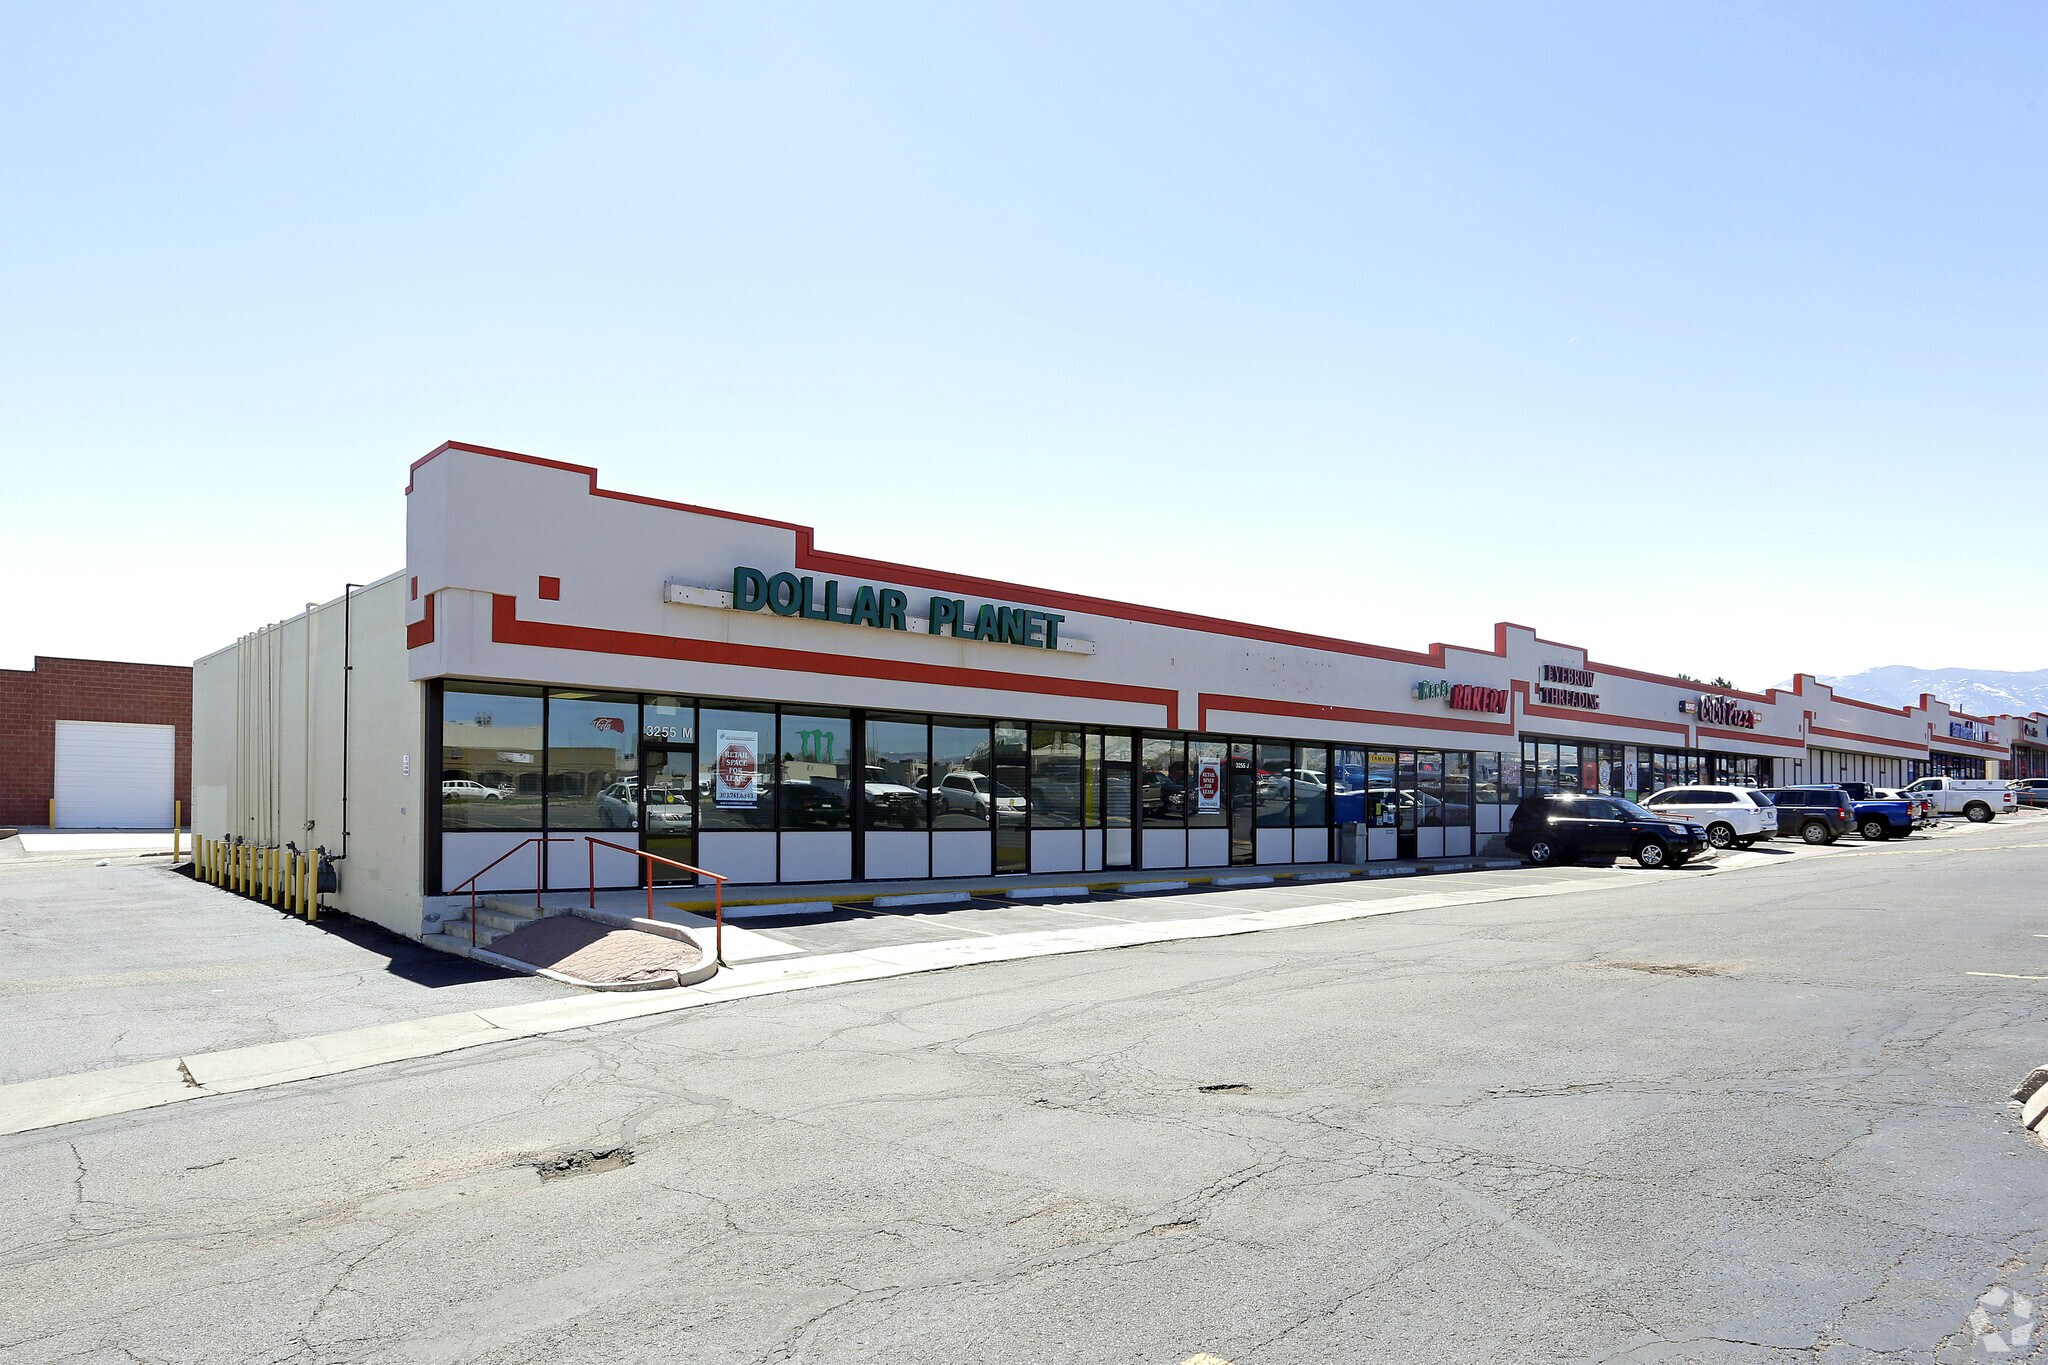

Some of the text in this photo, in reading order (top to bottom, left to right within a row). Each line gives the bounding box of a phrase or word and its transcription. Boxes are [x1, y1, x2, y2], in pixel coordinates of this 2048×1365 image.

[733, 565, 1065, 650] DOLLAR PLANET
[1544, 664, 1596, 687] EYEBROW
[1449, 683, 1509, 714] BAKERY
[1542, 688, 1600, 709] THREADING
[646, 725, 693, 738] 3255 M
[724, 751, 749, 759] RETAIL
